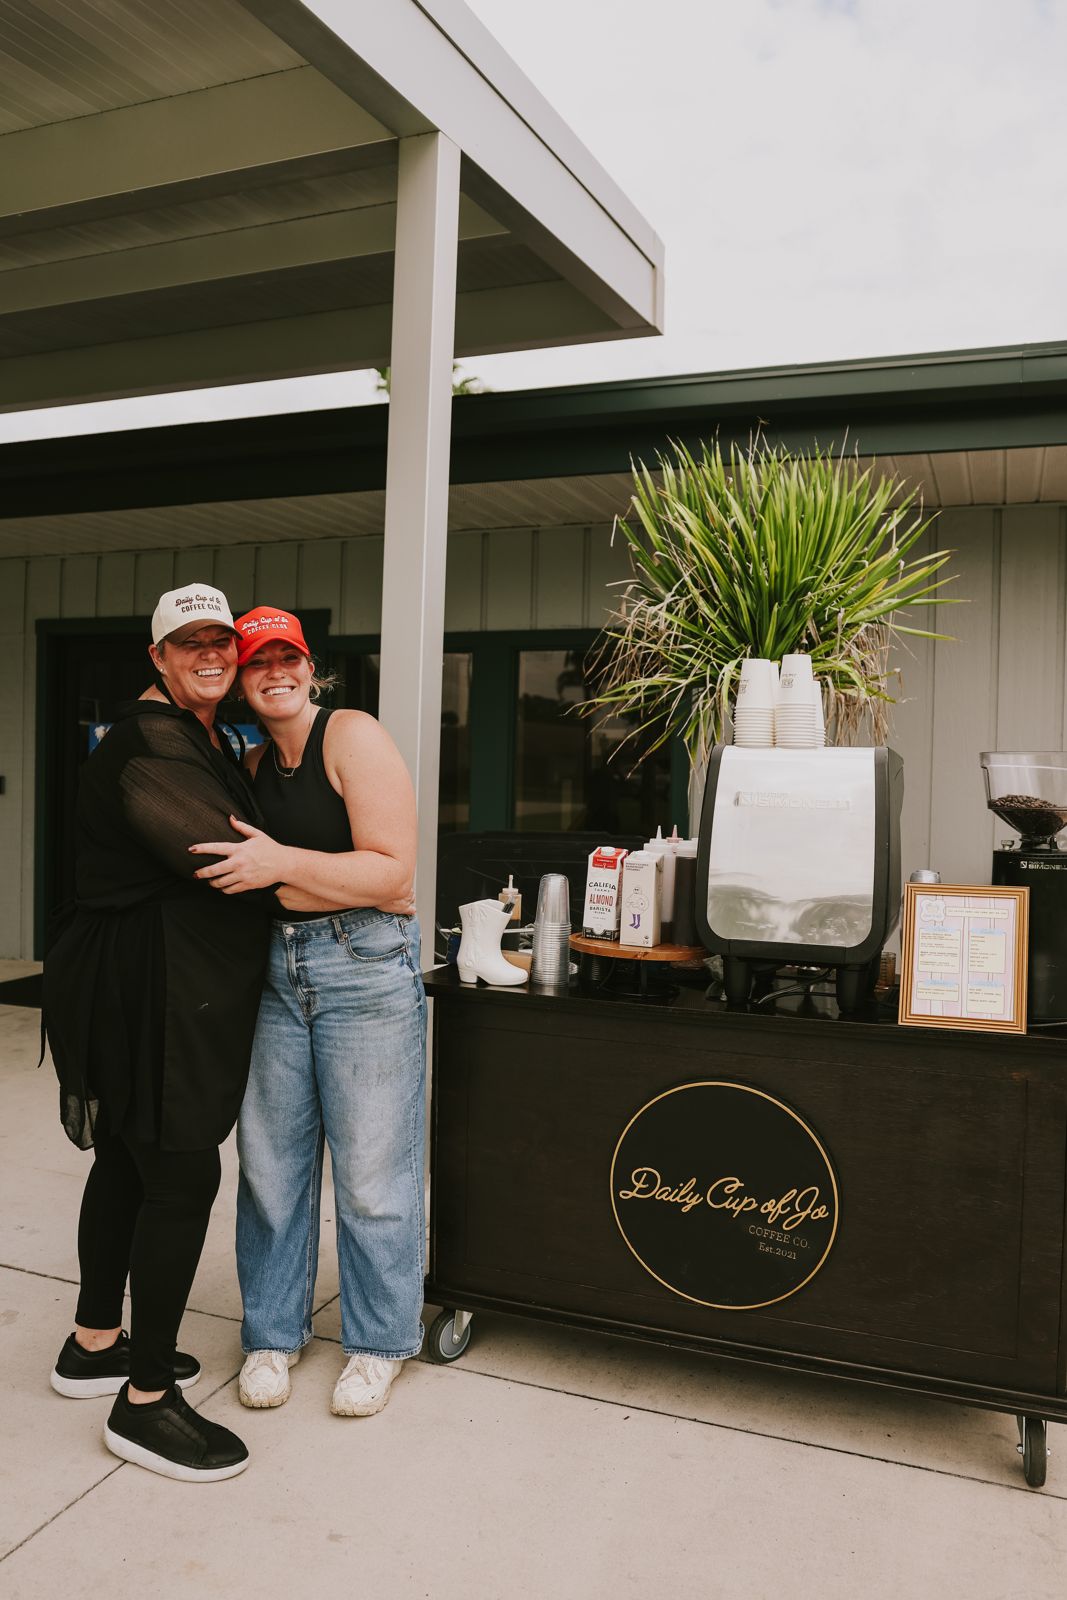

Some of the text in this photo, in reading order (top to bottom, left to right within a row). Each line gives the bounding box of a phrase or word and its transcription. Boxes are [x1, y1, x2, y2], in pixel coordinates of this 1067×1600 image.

[175, 596, 194, 607] Daily
[195, 594, 208, 602] Cup
[181, 603, 206, 613] COFFEE
[241, 620, 259, 631] Daily
[260, 616, 273, 624] Cup
[247, 625, 269, 635] COFFEE
[588, 881, 616, 890] CALIFIA
[589, 893, 614, 907] ALMOND
[619, 1166, 829, 1230] Daily Cup of Jo
[748, 1224, 811, 1249] COFFEE CO.
[758, 1242, 797, 1260] Est.2021
